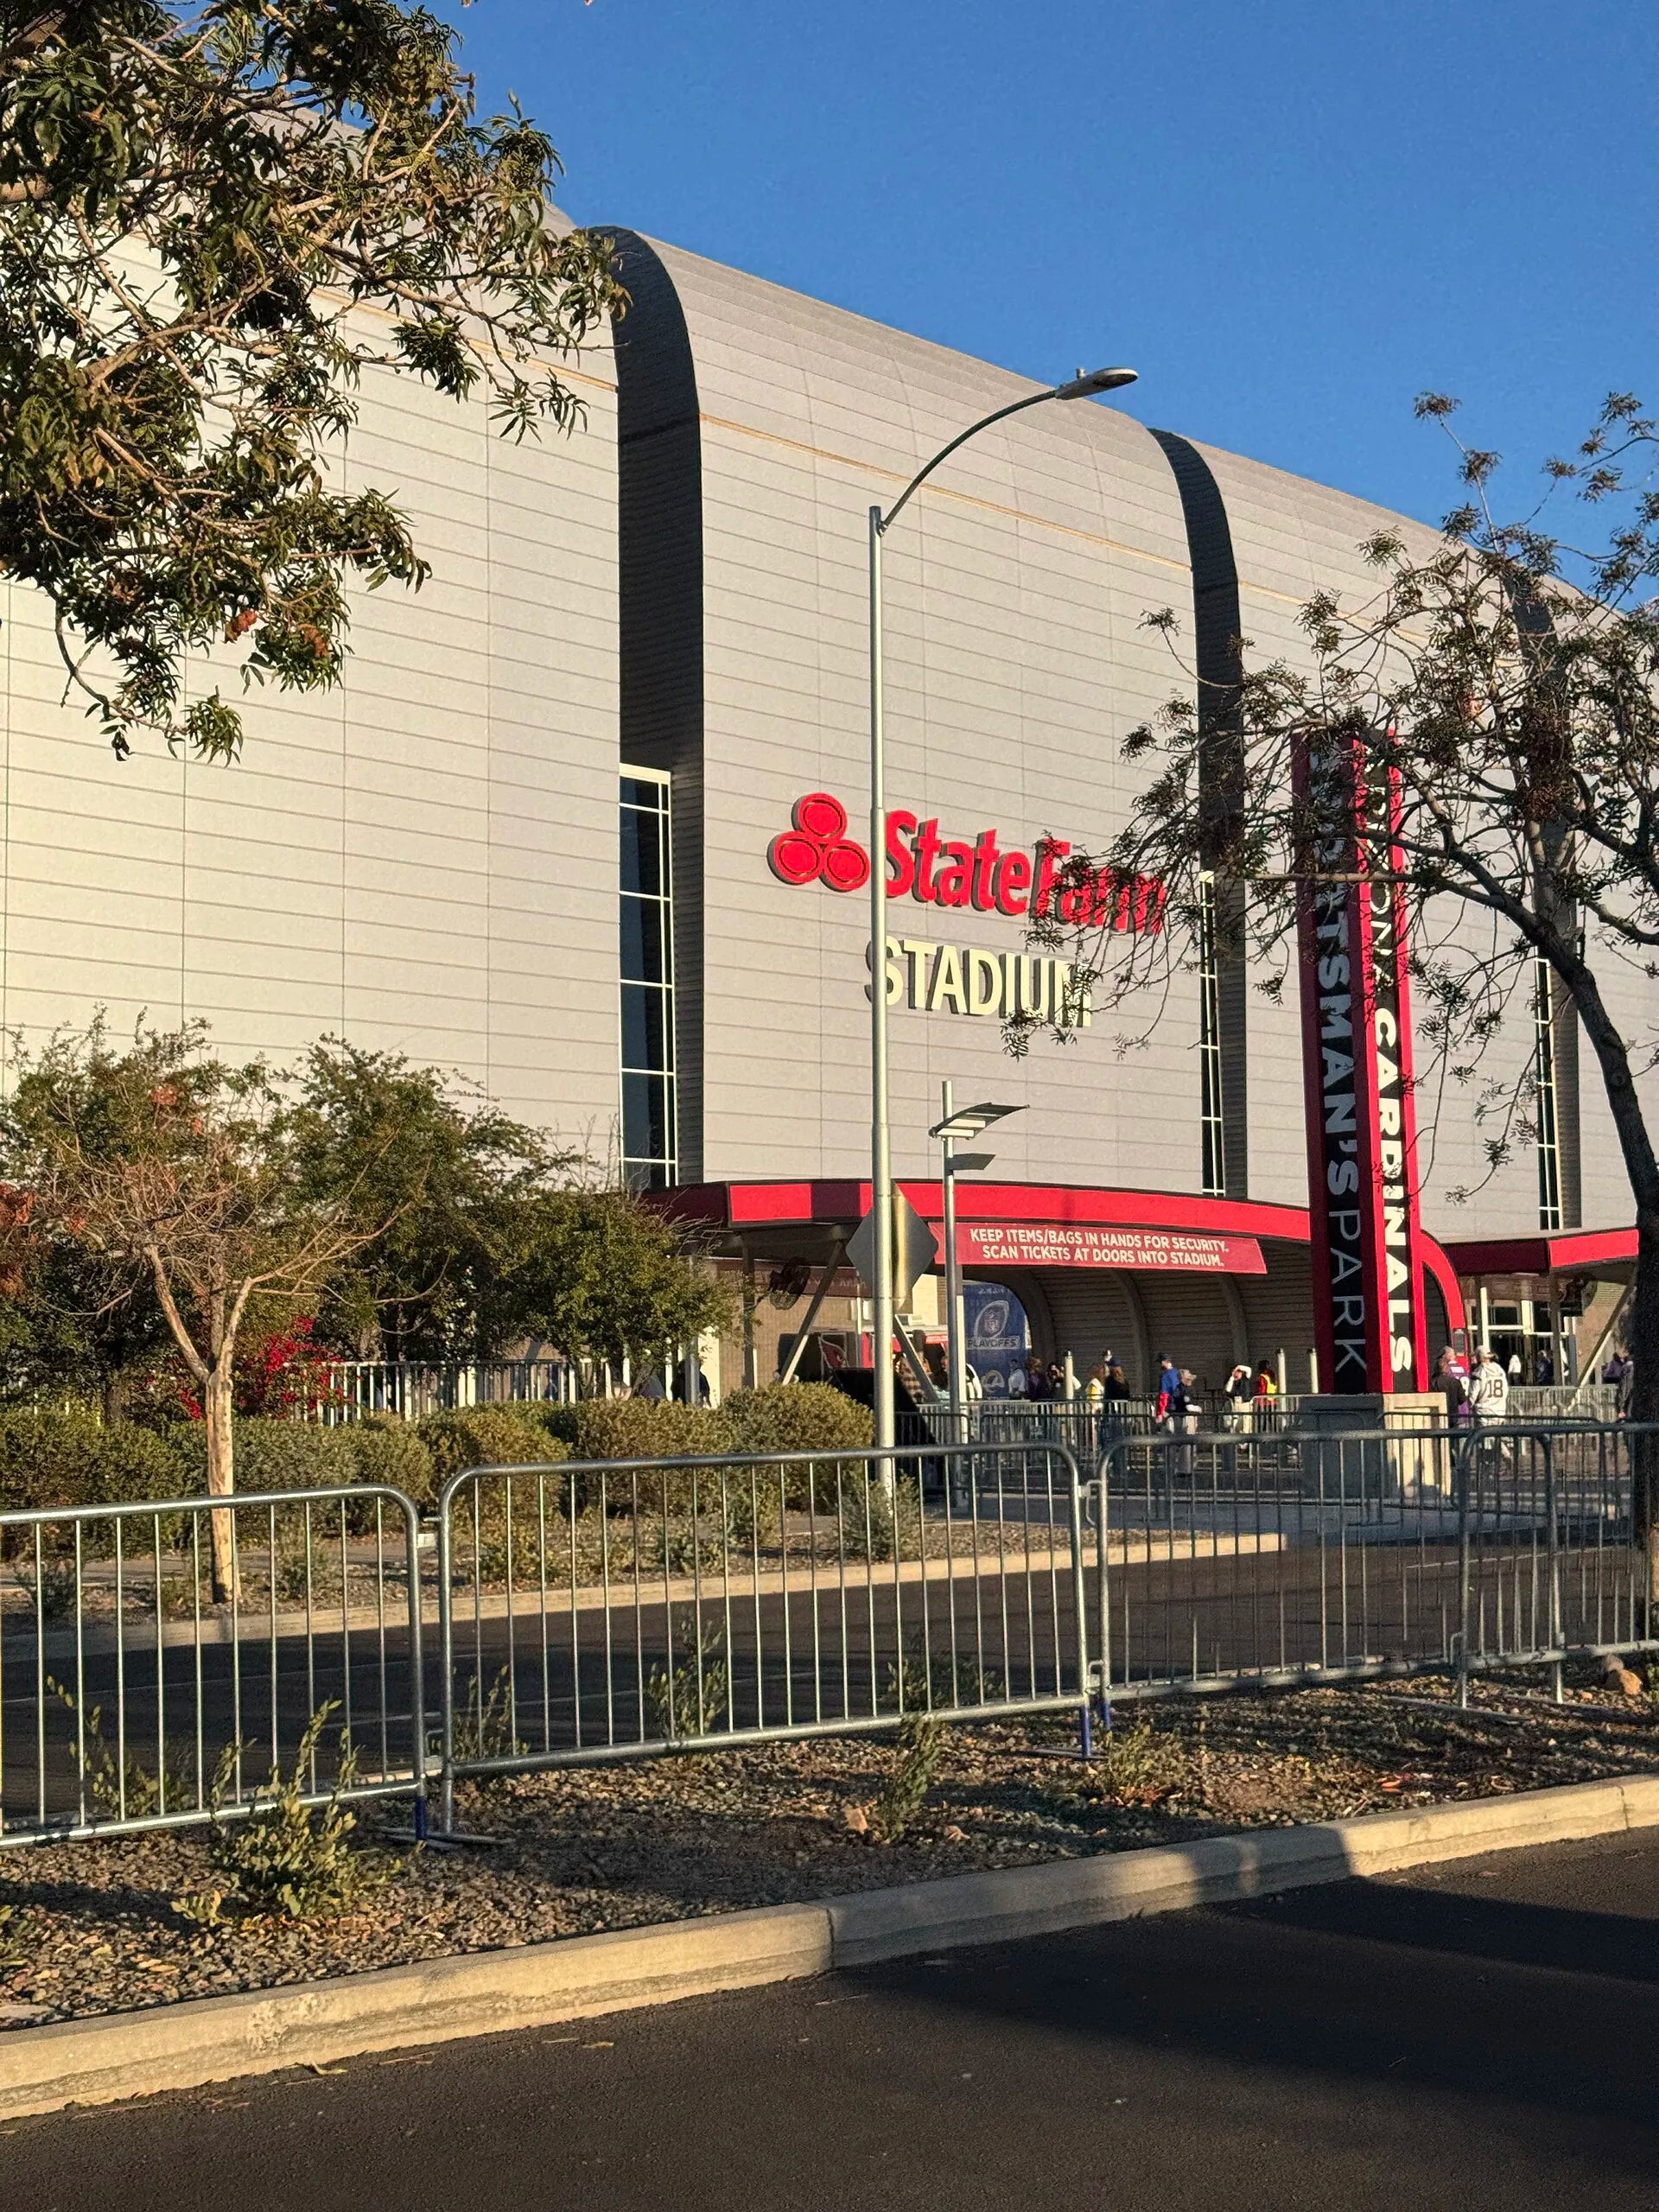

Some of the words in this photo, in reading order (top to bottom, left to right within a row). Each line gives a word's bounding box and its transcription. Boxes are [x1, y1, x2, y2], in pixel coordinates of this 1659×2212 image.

[1309, 743, 1359, 1197] ORTSMAN'S
[1375, 1007, 1413, 1373] CARDINALS
[970, 1228, 1003, 1243] KEEP
[1006, 1228, 1083, 1245] ITEMS/BAGS
[1084, 1231, 1098, 1245] IN
[1101, 1232, 1141, 1247] HANDS
[1144, 1235, 1170, 1249] FOR
[1171, 1236, 1230, 1253] SECURITY.
[982, 1244, 1019, 1259] SCAN
[1020, 1245, 1071, 1261] TICKETS
[1073, 1247, 1090, 1262] AT
[1092, 1248, 1135, 1262] DOORS
[1137, 1249, 1166, 1264] INTO
[1170, 1251, 1224, 1267] STADIUM.
[1328, 1210, 1368, 1372] PARK
[968, 1338, 1017, 1348] PLAYOFFS
[1486, 1379, 1503, 1398] 18
